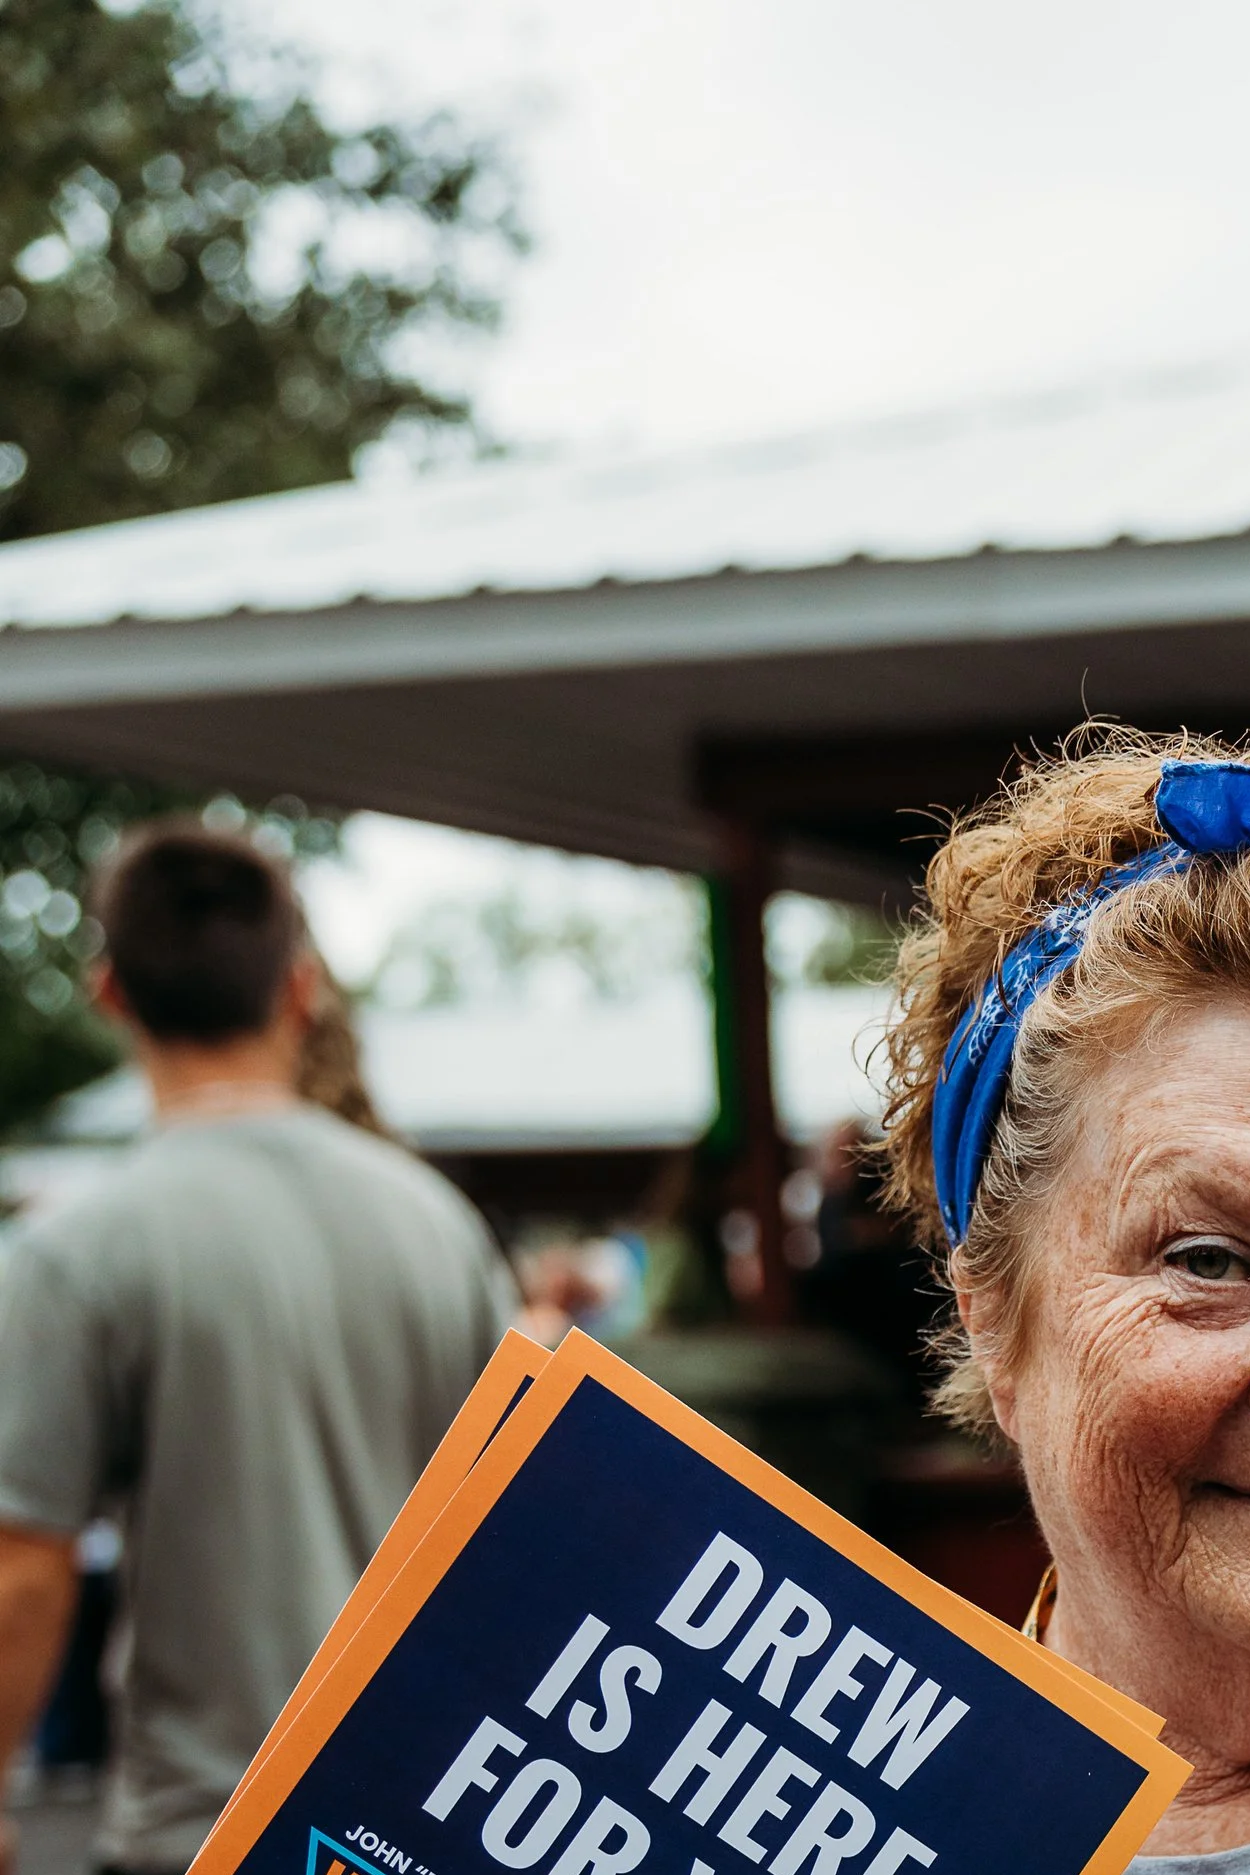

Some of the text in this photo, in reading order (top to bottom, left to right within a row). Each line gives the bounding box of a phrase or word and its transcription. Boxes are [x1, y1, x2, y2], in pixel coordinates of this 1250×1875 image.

[525, 1614, 662, 1753] IS
[656, 1531, 970, 1790] DREW
[345, 1825, 413, 1875] JOHN
